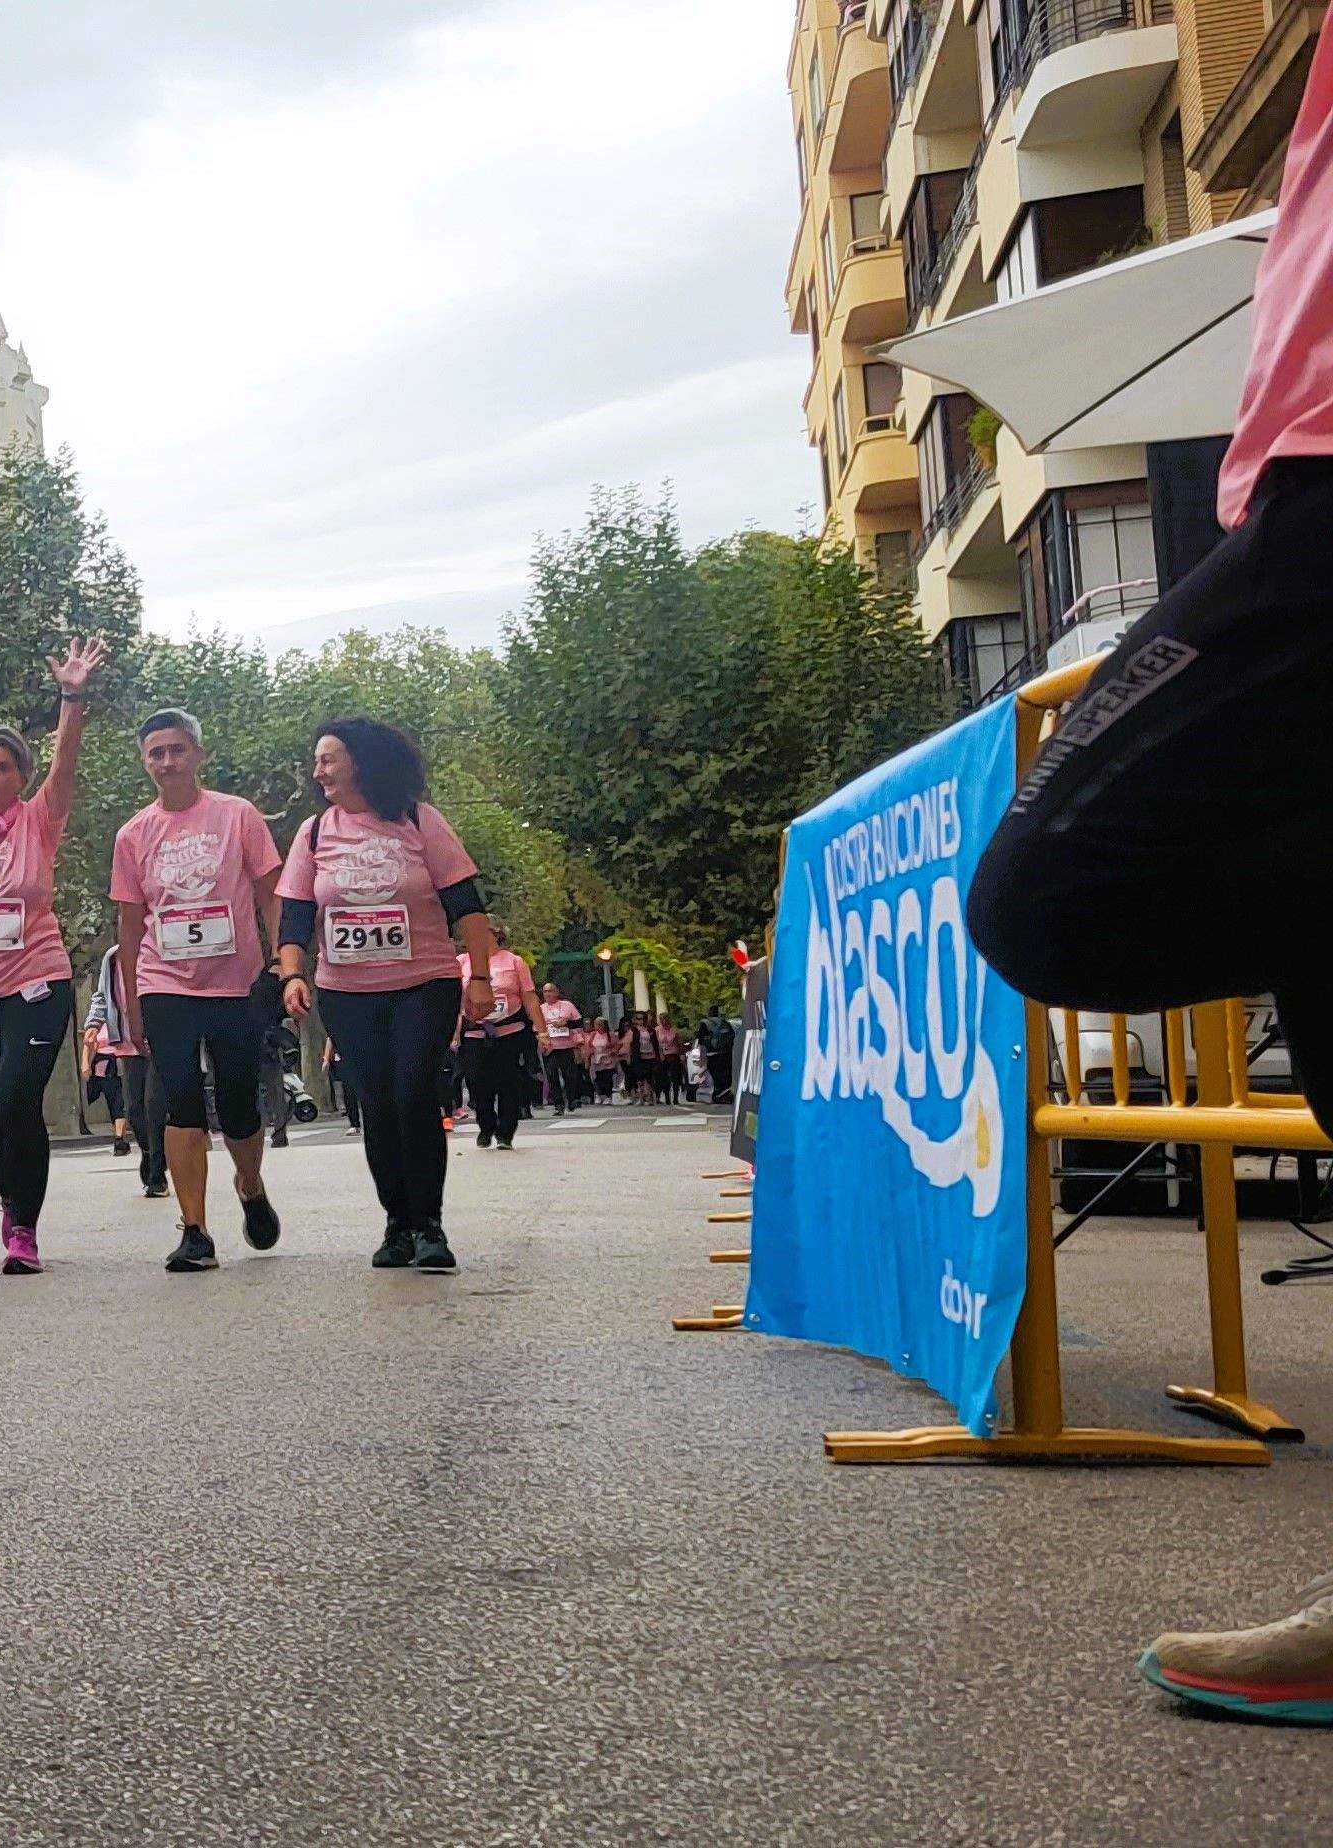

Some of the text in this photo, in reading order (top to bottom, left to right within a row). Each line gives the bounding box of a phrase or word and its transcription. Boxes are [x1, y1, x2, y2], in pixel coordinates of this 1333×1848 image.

[1064, 641, 1188, 742] SPEAKER
[188, 923, 203, 944] 5
[334, 925, 404, 949] 2916
[801, 846, 968, 1101] blasco
